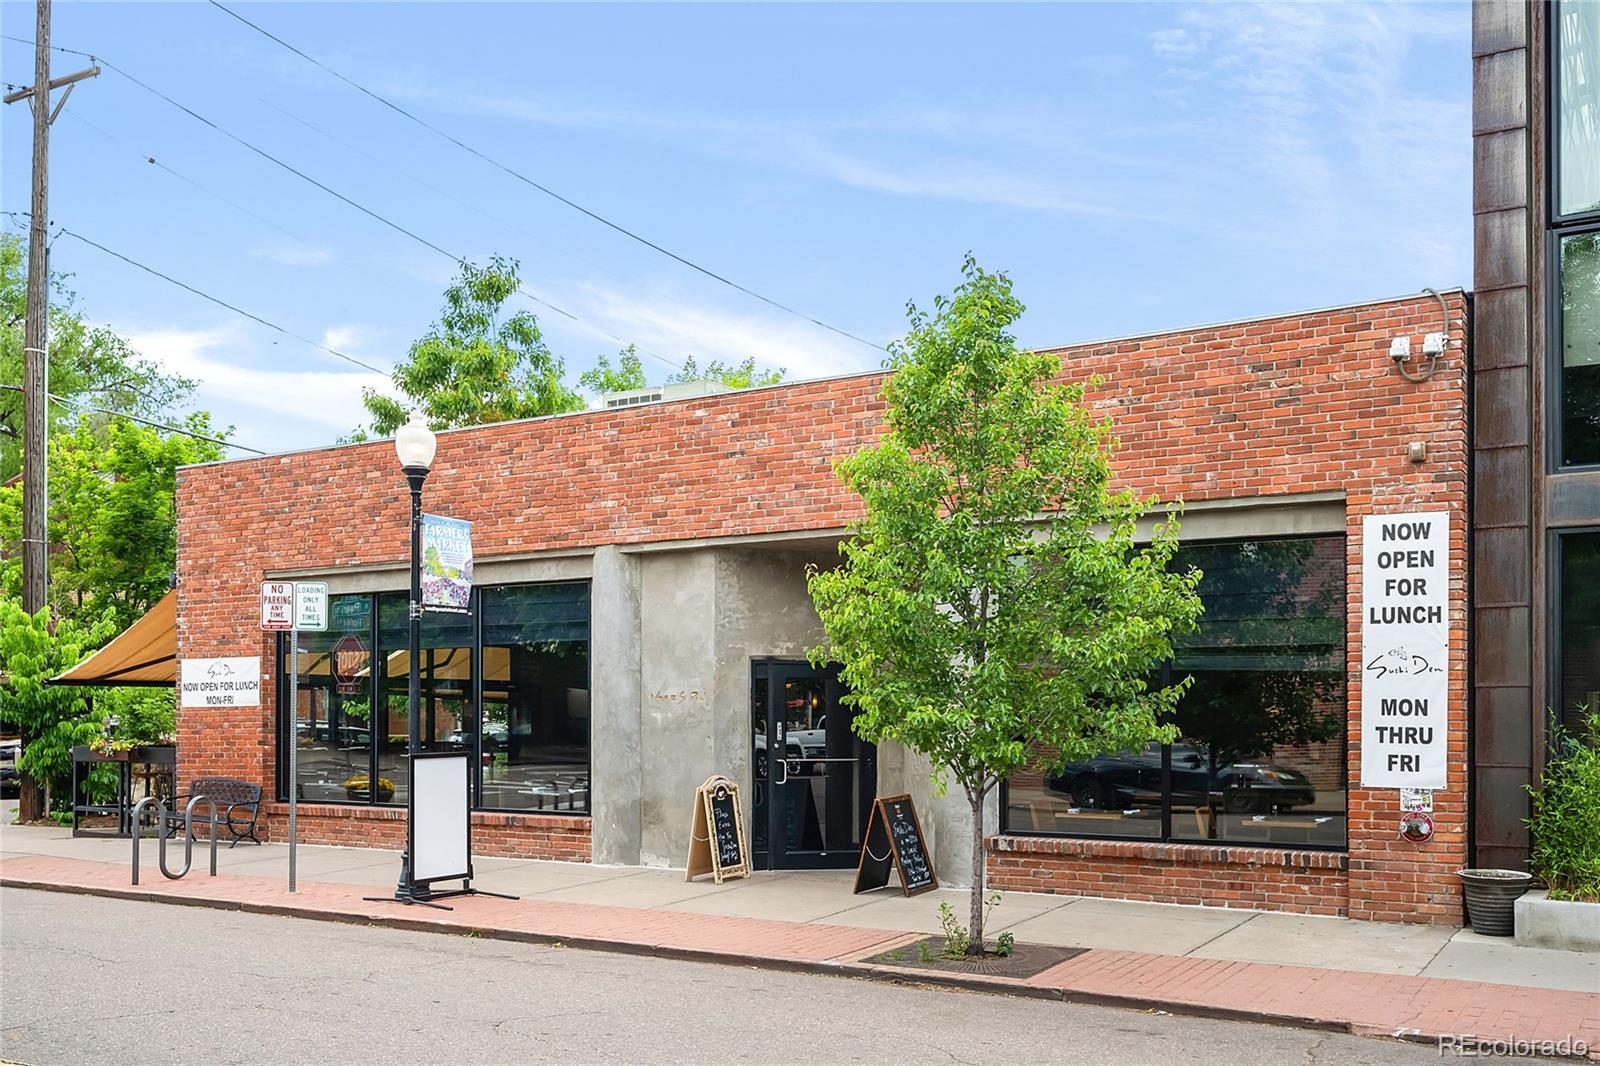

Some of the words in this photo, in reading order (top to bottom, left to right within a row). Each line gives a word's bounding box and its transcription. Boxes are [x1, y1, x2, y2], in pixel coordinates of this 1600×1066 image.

[1382, 522, 1431, 541] NOW
[1377, 550, 1434, 569] OPEN
[271, 585, 284, 593] NO
[1385, 578, 1427, 597] FOR
[264, 596, 292, 605] PARKING
[1370, 606, 1442, 624] LUNCH
[1366, 654, 1408, 679] Sushi
[1412, 655, 1444, 675] Den
[183, 682, 199, 692] NOW
[200, 682, 218, 691] OPEN
[220, 681, 234, 691] FOR
[235, 681, 258, 690] LUNCH
[206, 695, 234, 705] MON-FRI
[1381, 699, 1428, 716] MON
[1375, 726, 1433, 744] THRU
[1387, 754, 1420, 772] FRI
